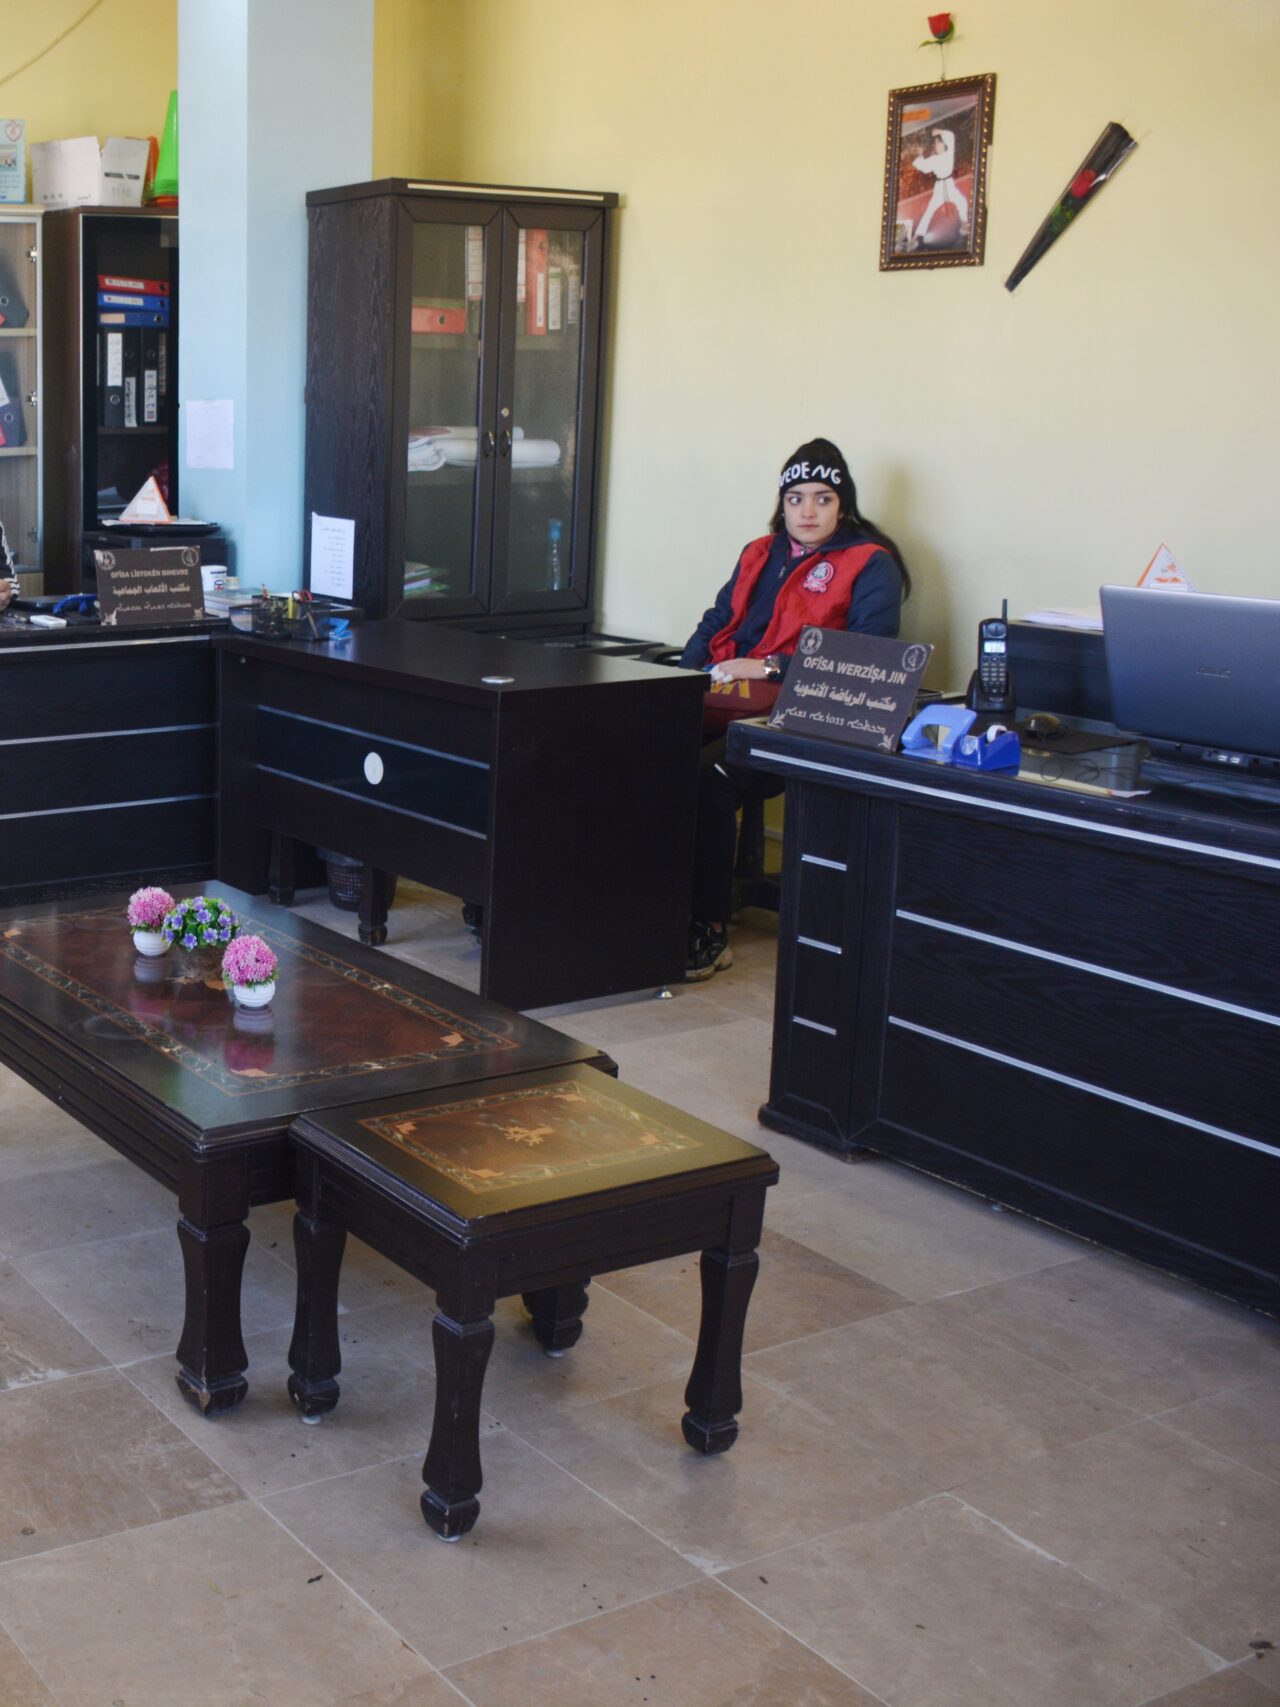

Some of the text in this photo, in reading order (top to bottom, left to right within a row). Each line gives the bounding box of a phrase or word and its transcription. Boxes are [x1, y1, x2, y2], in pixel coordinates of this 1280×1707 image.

[887, 671, 907, 685] JIN
[829, 686, 866, 707] الرياضة
[865, 696, 897, 713] مكتب
